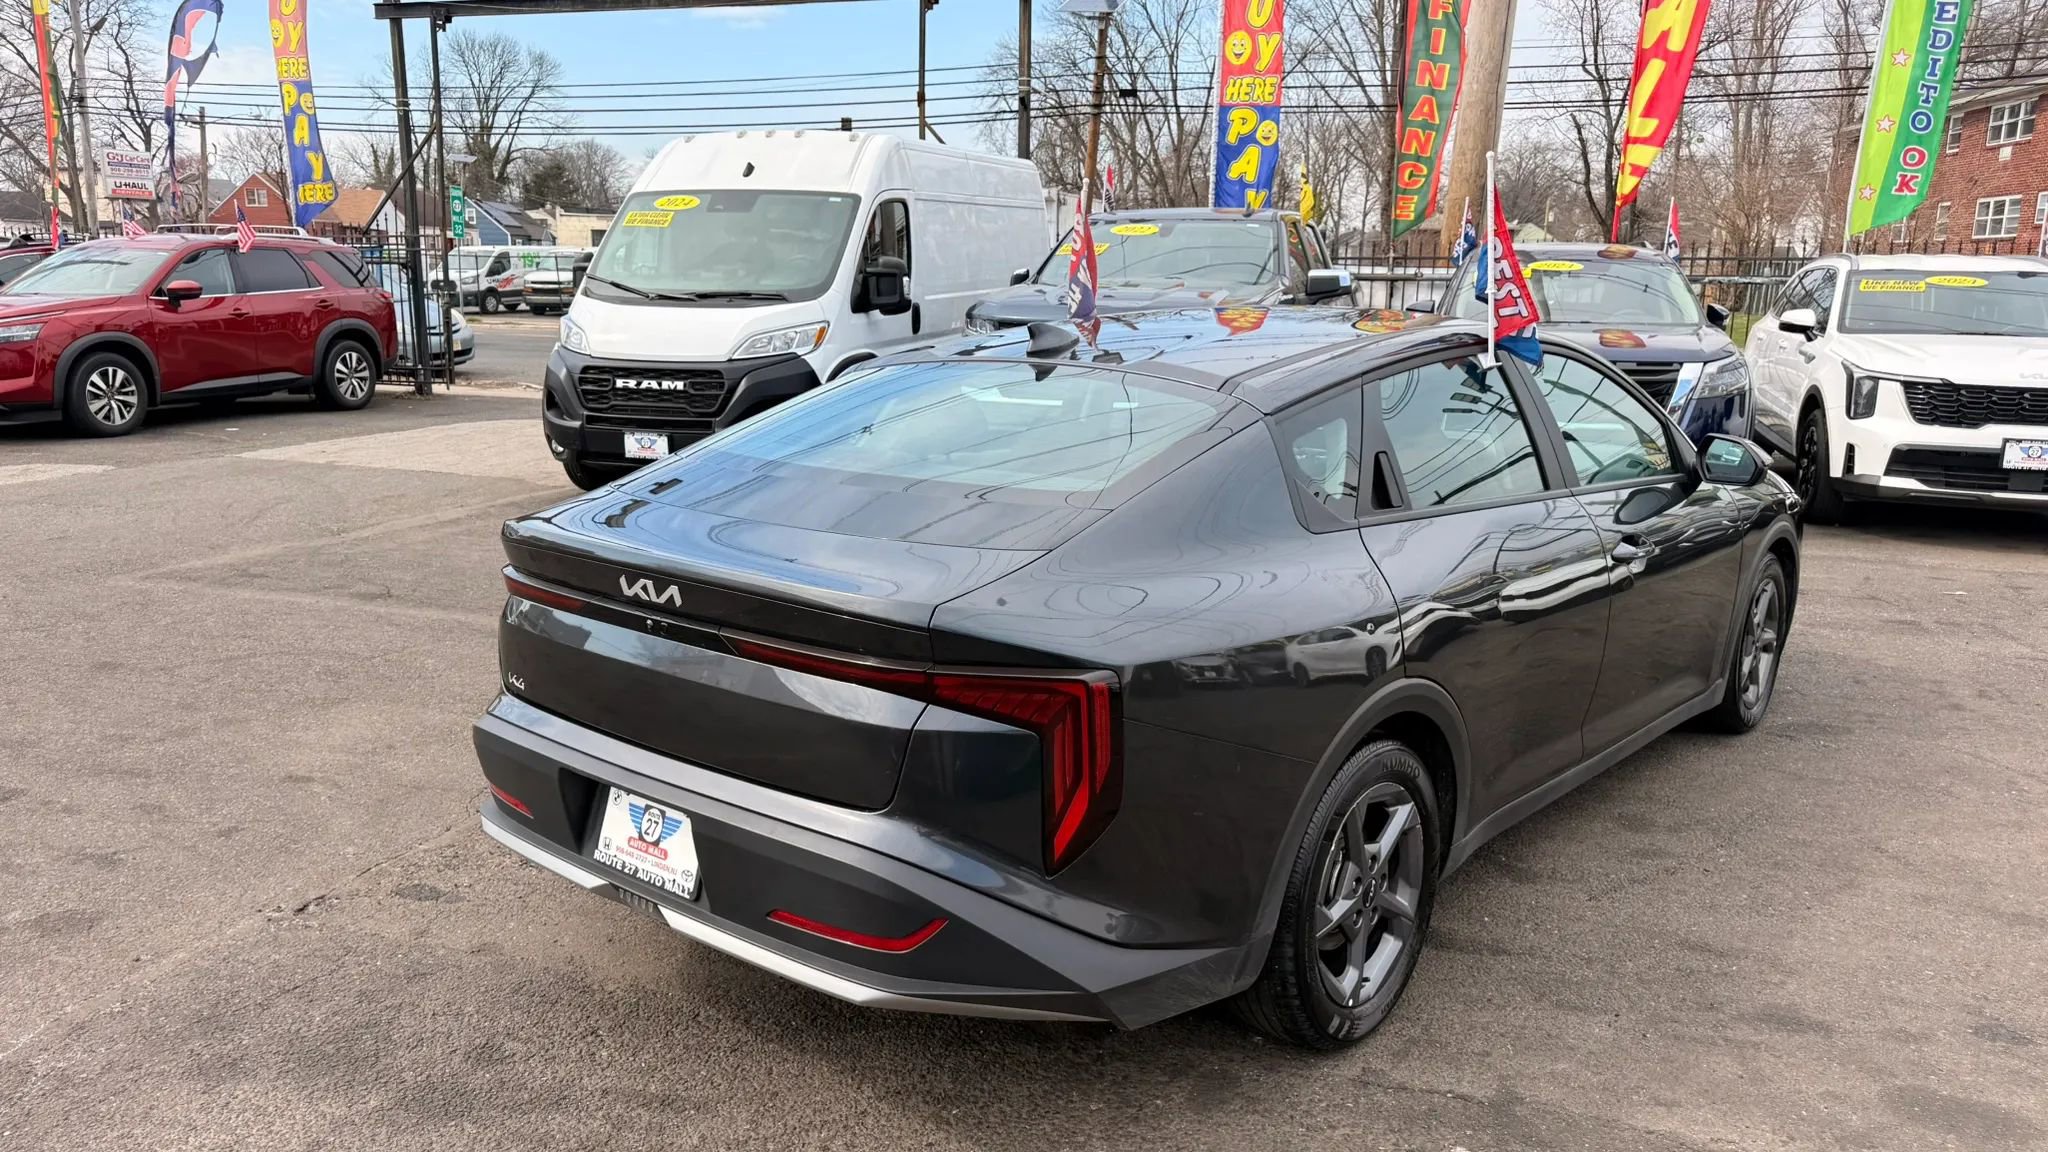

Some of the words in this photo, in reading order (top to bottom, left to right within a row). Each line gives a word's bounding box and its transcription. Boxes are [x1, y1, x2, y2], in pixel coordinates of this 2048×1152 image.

[1224, 74, 1279, 104] HERE
[1392, 0, 1453, 220] FINANCE
[1892, 145, 1929, 196] OK
[114, 181, 149, 190] U-HAUL
[454, 224, 463, 234] 32
[615, 378, 685, 391] RAM
[643, 818, 660, 838] 27
[593, 849, 622, 870] ROUTE
[624, 859, 636, 875] 27
[636, 867, 664, 887] AUTO
[664, 876, 692, 899] MALL
